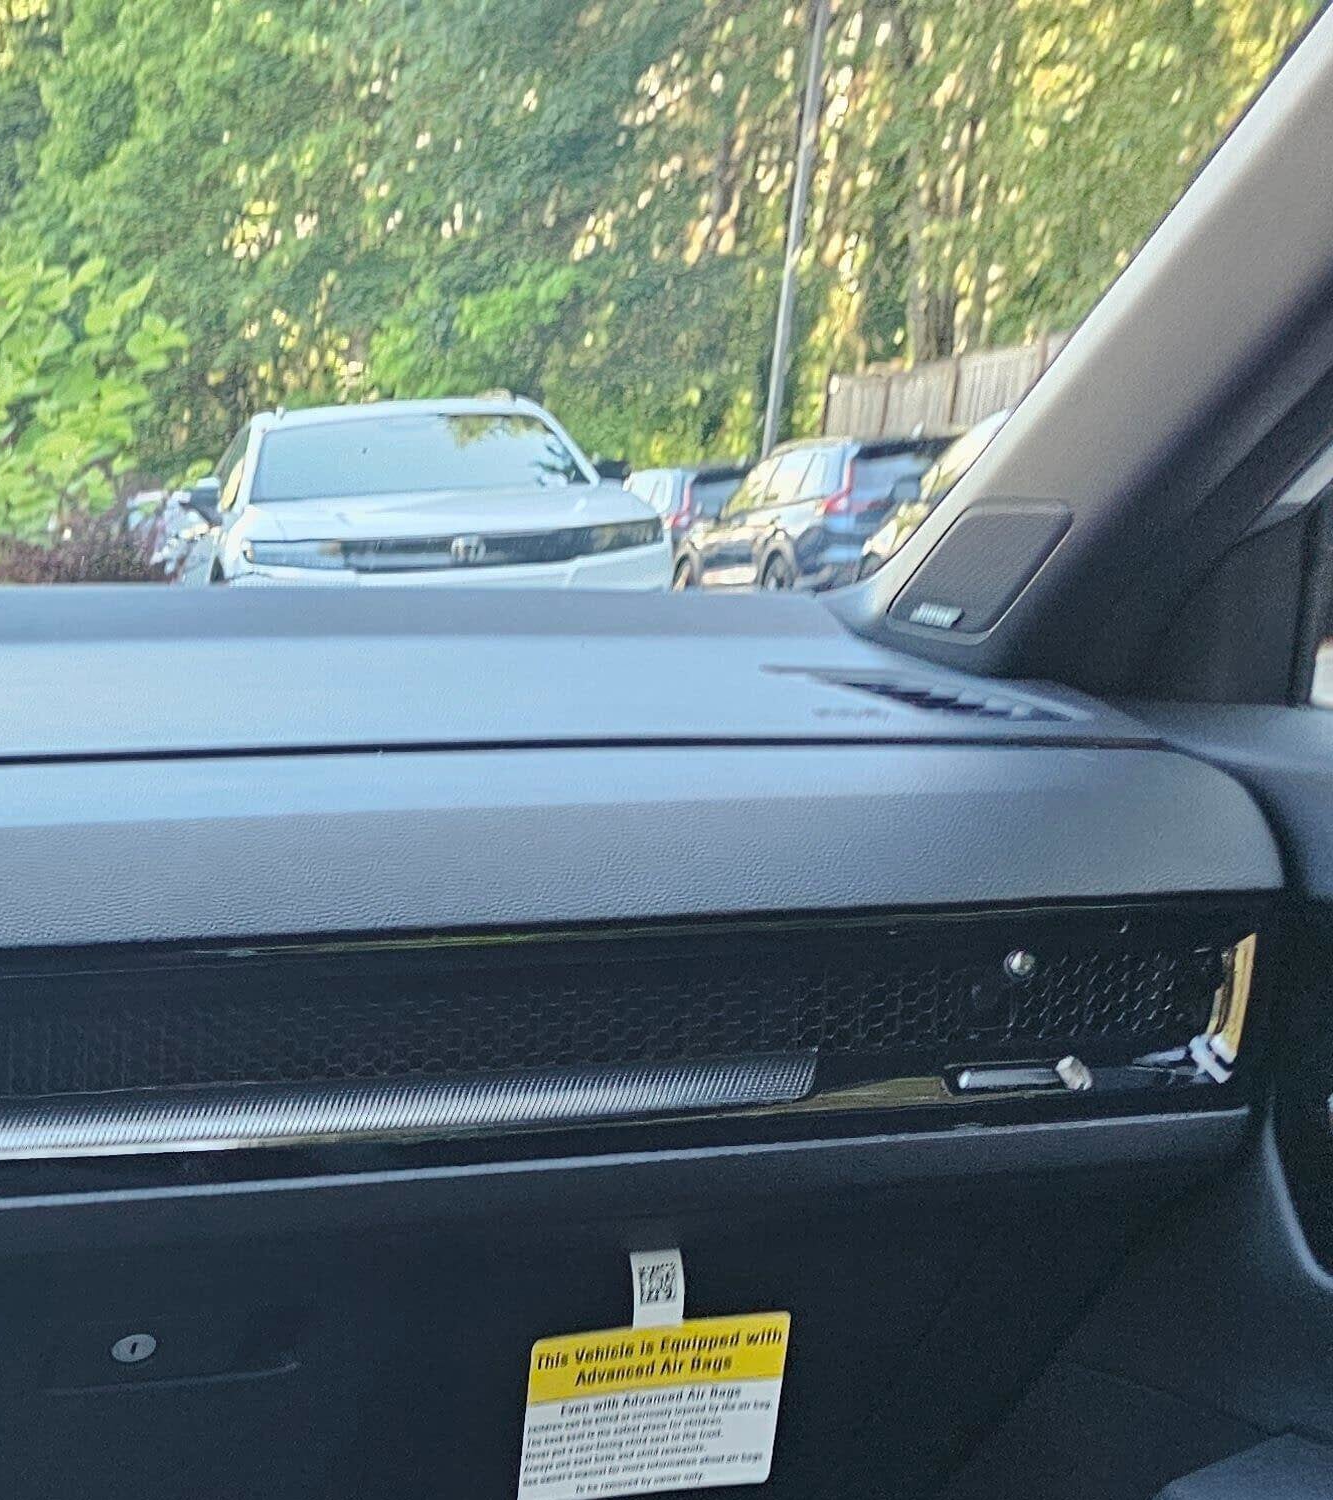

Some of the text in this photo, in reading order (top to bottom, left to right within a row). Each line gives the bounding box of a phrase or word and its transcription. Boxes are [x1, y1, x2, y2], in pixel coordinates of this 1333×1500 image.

[537, 1351, 569, 1371] This
[575, 1341, 634, 1364] Vehicle
[660, 1331, 740, 1355] Equipped
[747, 1326, 782, 1346] with
[575, 1355, 732, 1387] Advanced Air Bags
[560, 1404, 589, 1416] Even
[594, 1398, 618, 1411] with
[623, 1390, 683, 1407] Advanced
[688, 1388, 705, 1401] Air
